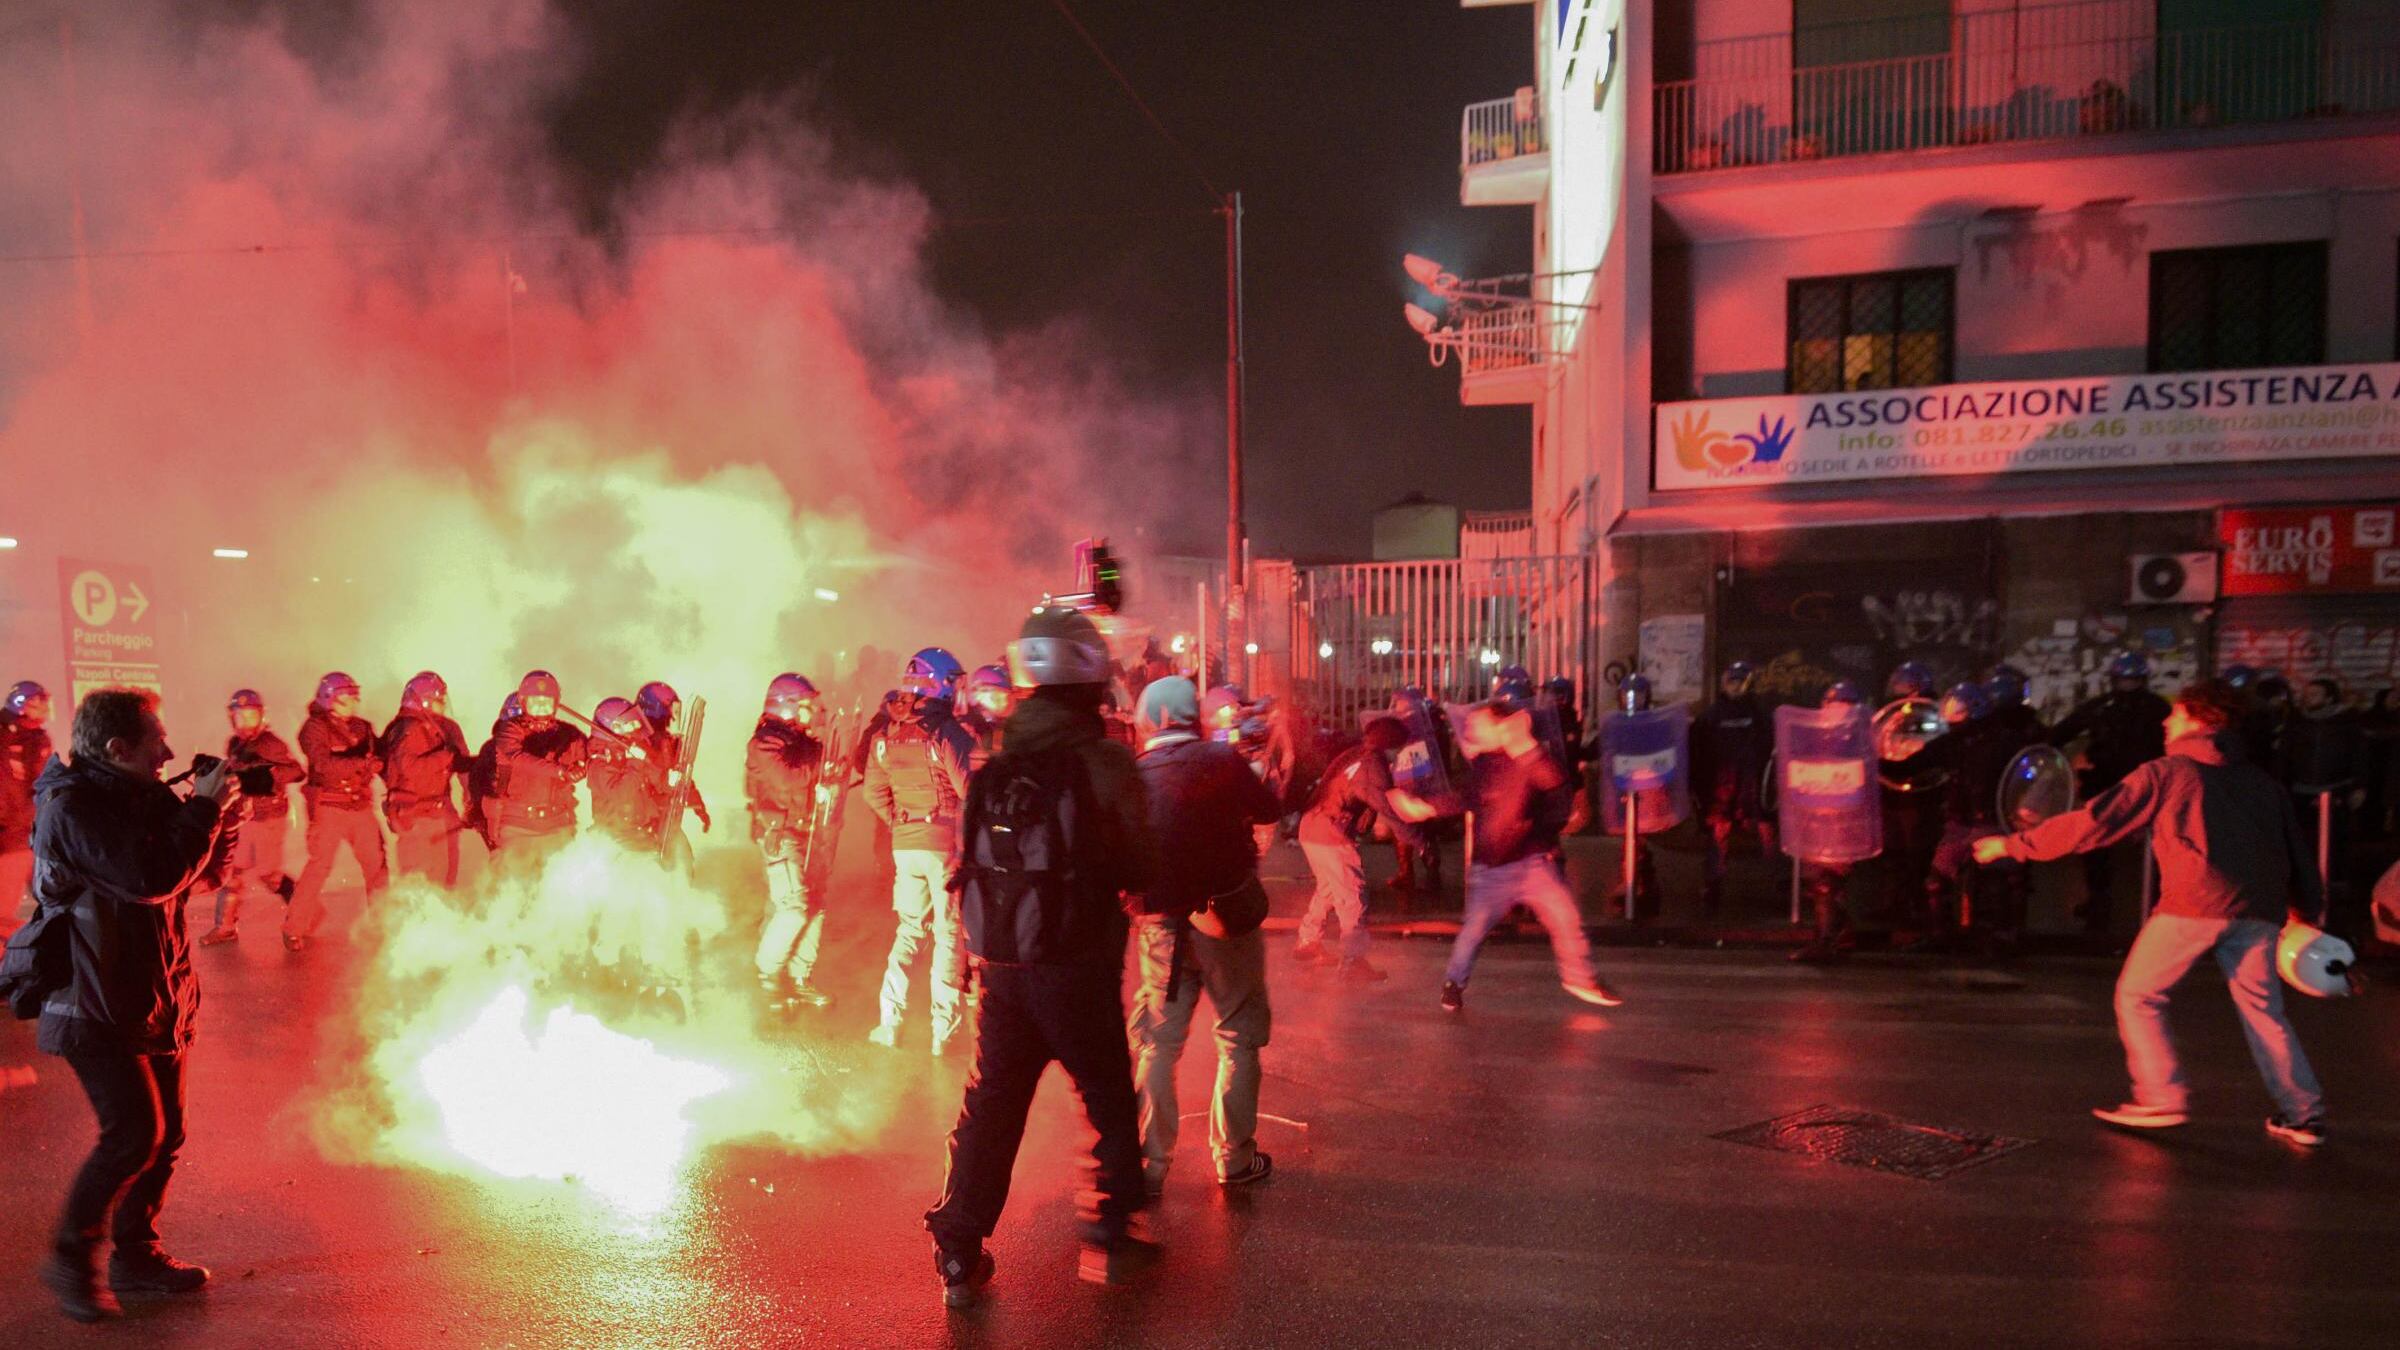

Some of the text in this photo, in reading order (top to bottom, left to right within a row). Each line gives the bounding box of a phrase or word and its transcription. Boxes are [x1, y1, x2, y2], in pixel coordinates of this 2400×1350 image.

[1807, 386, 2110, 429] ASSOCIAZIONE
[2123, 373, 2377, 411] ASSISTENZA
[1839, 432, 1906, 451] info:
[1914, 418, 2127, 447] 081.827.26.46
[1800, 458, 1849, 473] SEDIE
[1856, 456, 1870, 470] A
[1875, 451, 1947, 470] ROTELLE
[2024, 443, 2136, 463] ORTOPEDICI
[2235, 527, 2334, 551] EURO
[2232, 551, 2333, 575] SERVIS
[85, 582, 107, 617] P
[73, 627, 153, 651] Parcheggio
[76, 668, 112, 683] Napoli
